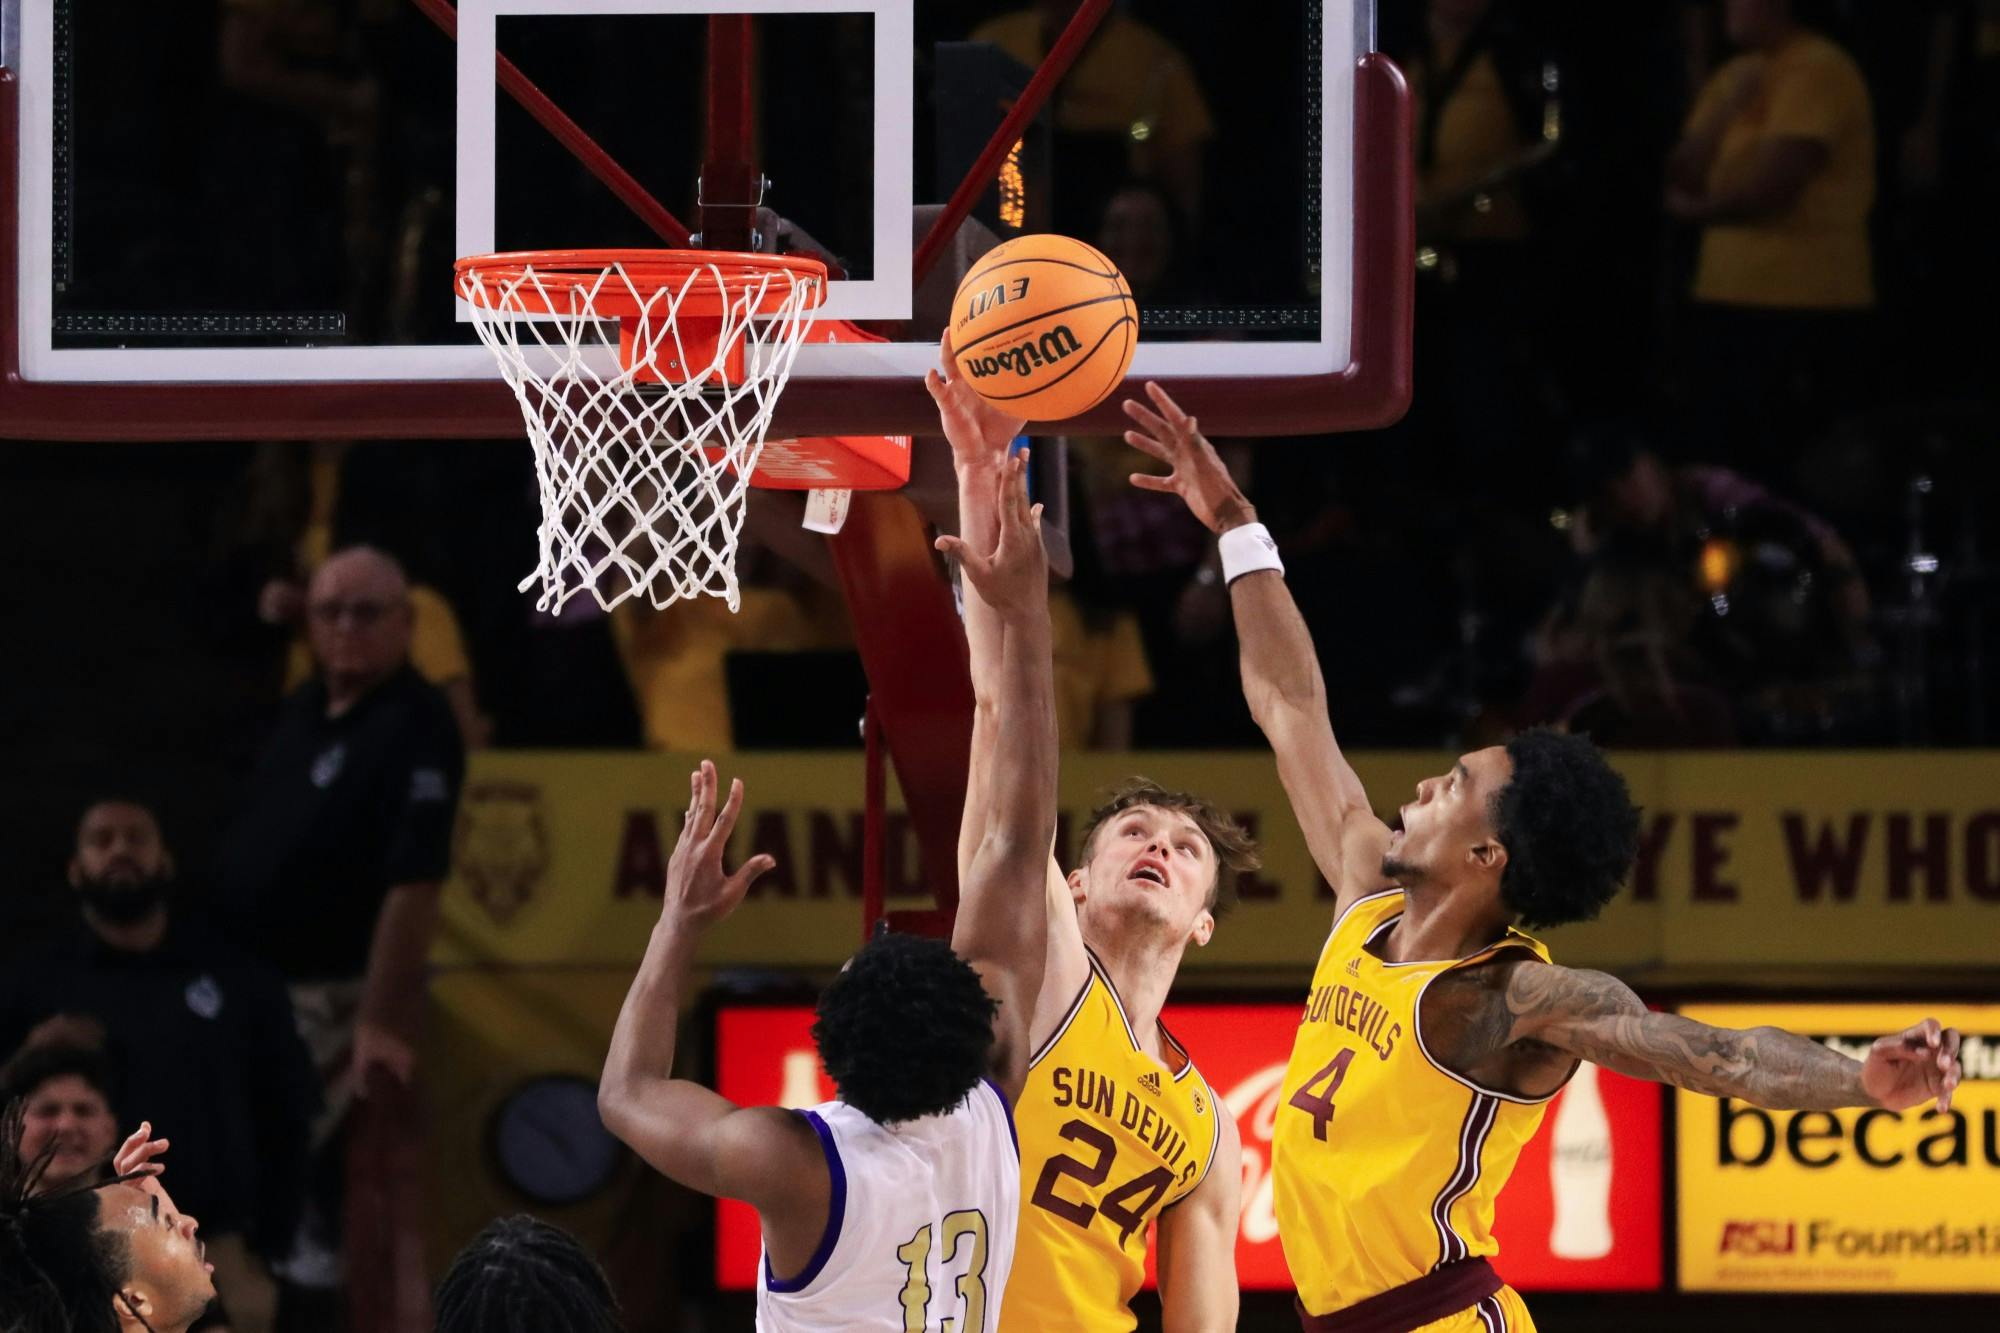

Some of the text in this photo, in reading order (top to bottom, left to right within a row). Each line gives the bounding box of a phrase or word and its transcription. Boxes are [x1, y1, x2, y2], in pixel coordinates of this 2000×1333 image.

[968, 276, 1030, 321] EVO
[966, 325, 1083, 378] Wilson
[1335, 984, 1402, 1061] DEVILS
[1137, 1076, 1162, 1097] adidas
[1288, 1047, 1356, 1142] 4
[1053, 1067, 1115, 1118] SUN
[1120, 1091, 1197, 1187] DEVILS
[1718, 1098, 2000, 1169] beca
[1031, 1118, 1177, 1254] 24
[896, 1208, 989, 1333] 13
[1719, 1220, 1796, 1254] ASU
